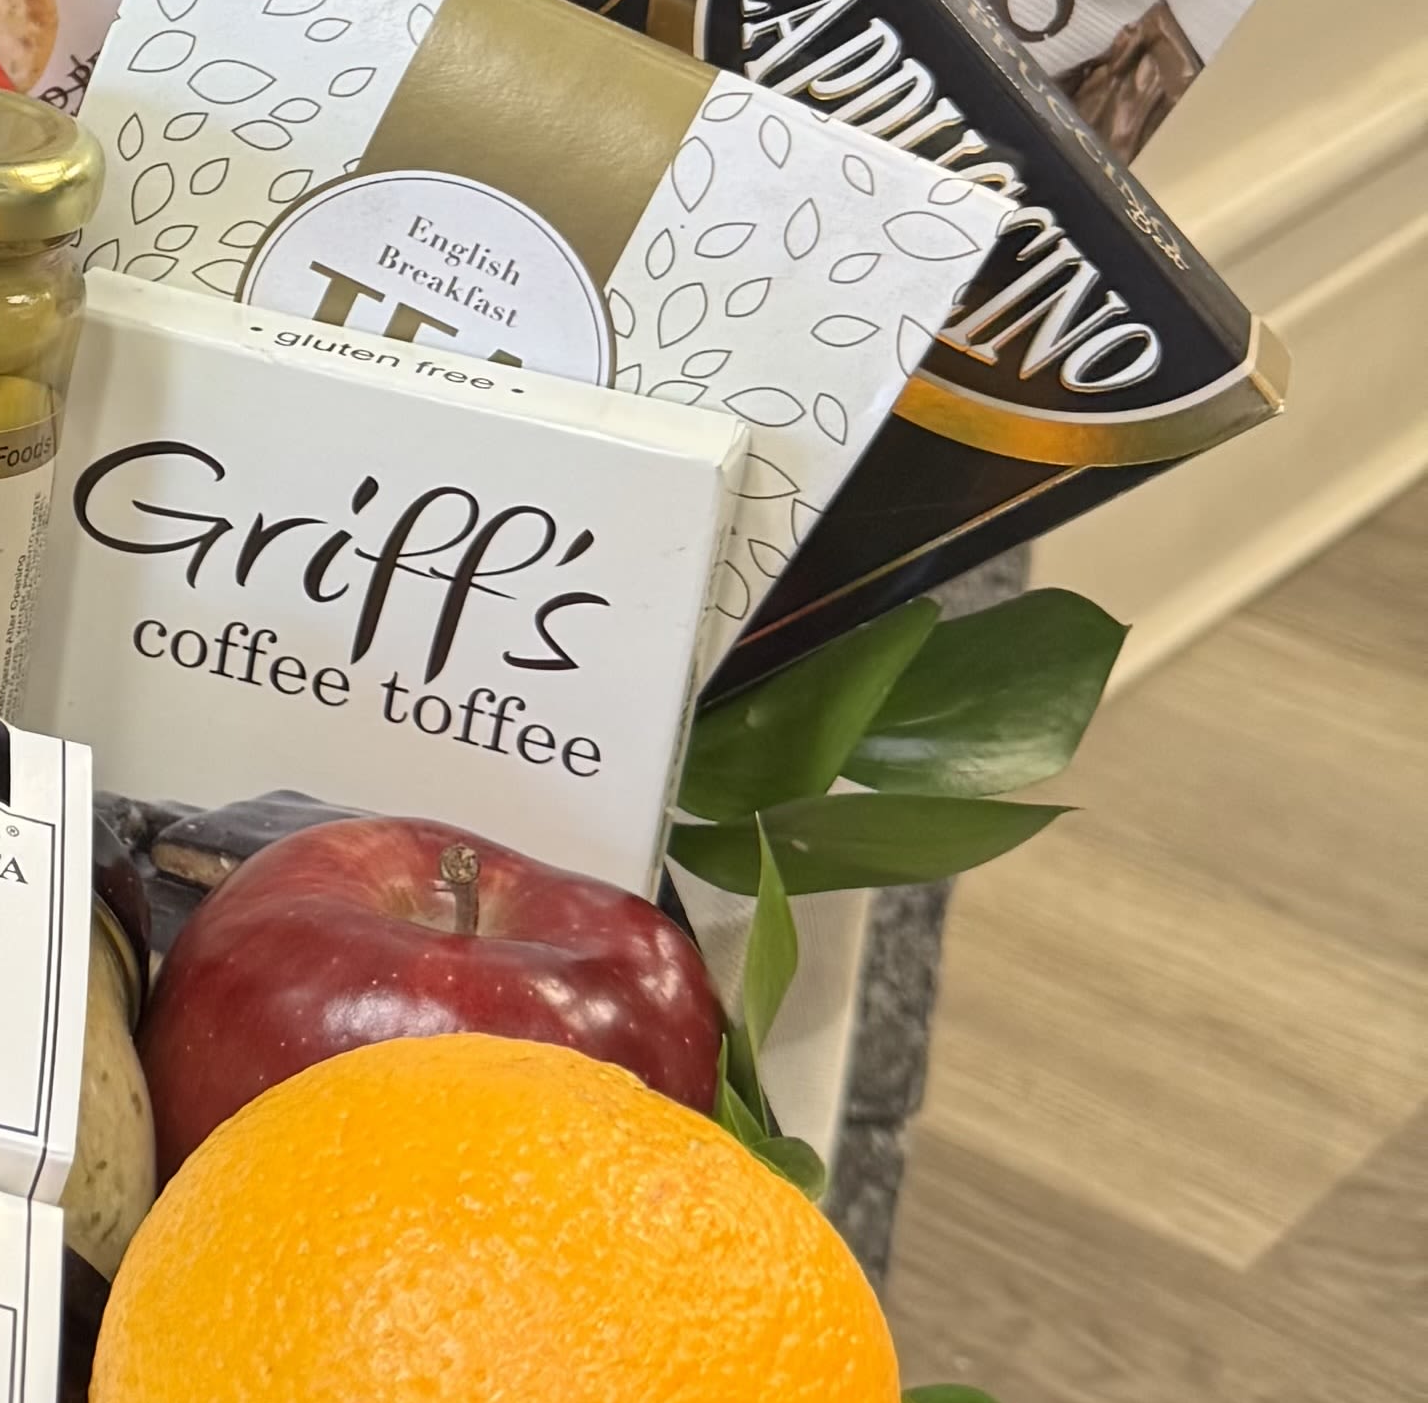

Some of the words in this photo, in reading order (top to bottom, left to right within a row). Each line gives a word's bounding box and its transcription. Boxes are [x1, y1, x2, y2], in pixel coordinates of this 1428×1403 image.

[376, 244, 519, 329] Breakfast
[406, 215, 521, 287] English
[274, 329, 401, 368] gluten
[416, 360, 495, 391] free
[72, 440, 611, 685] Griff's
[132, 619, 351, 707] coffee
[380, 670, 602, 778] toffee
